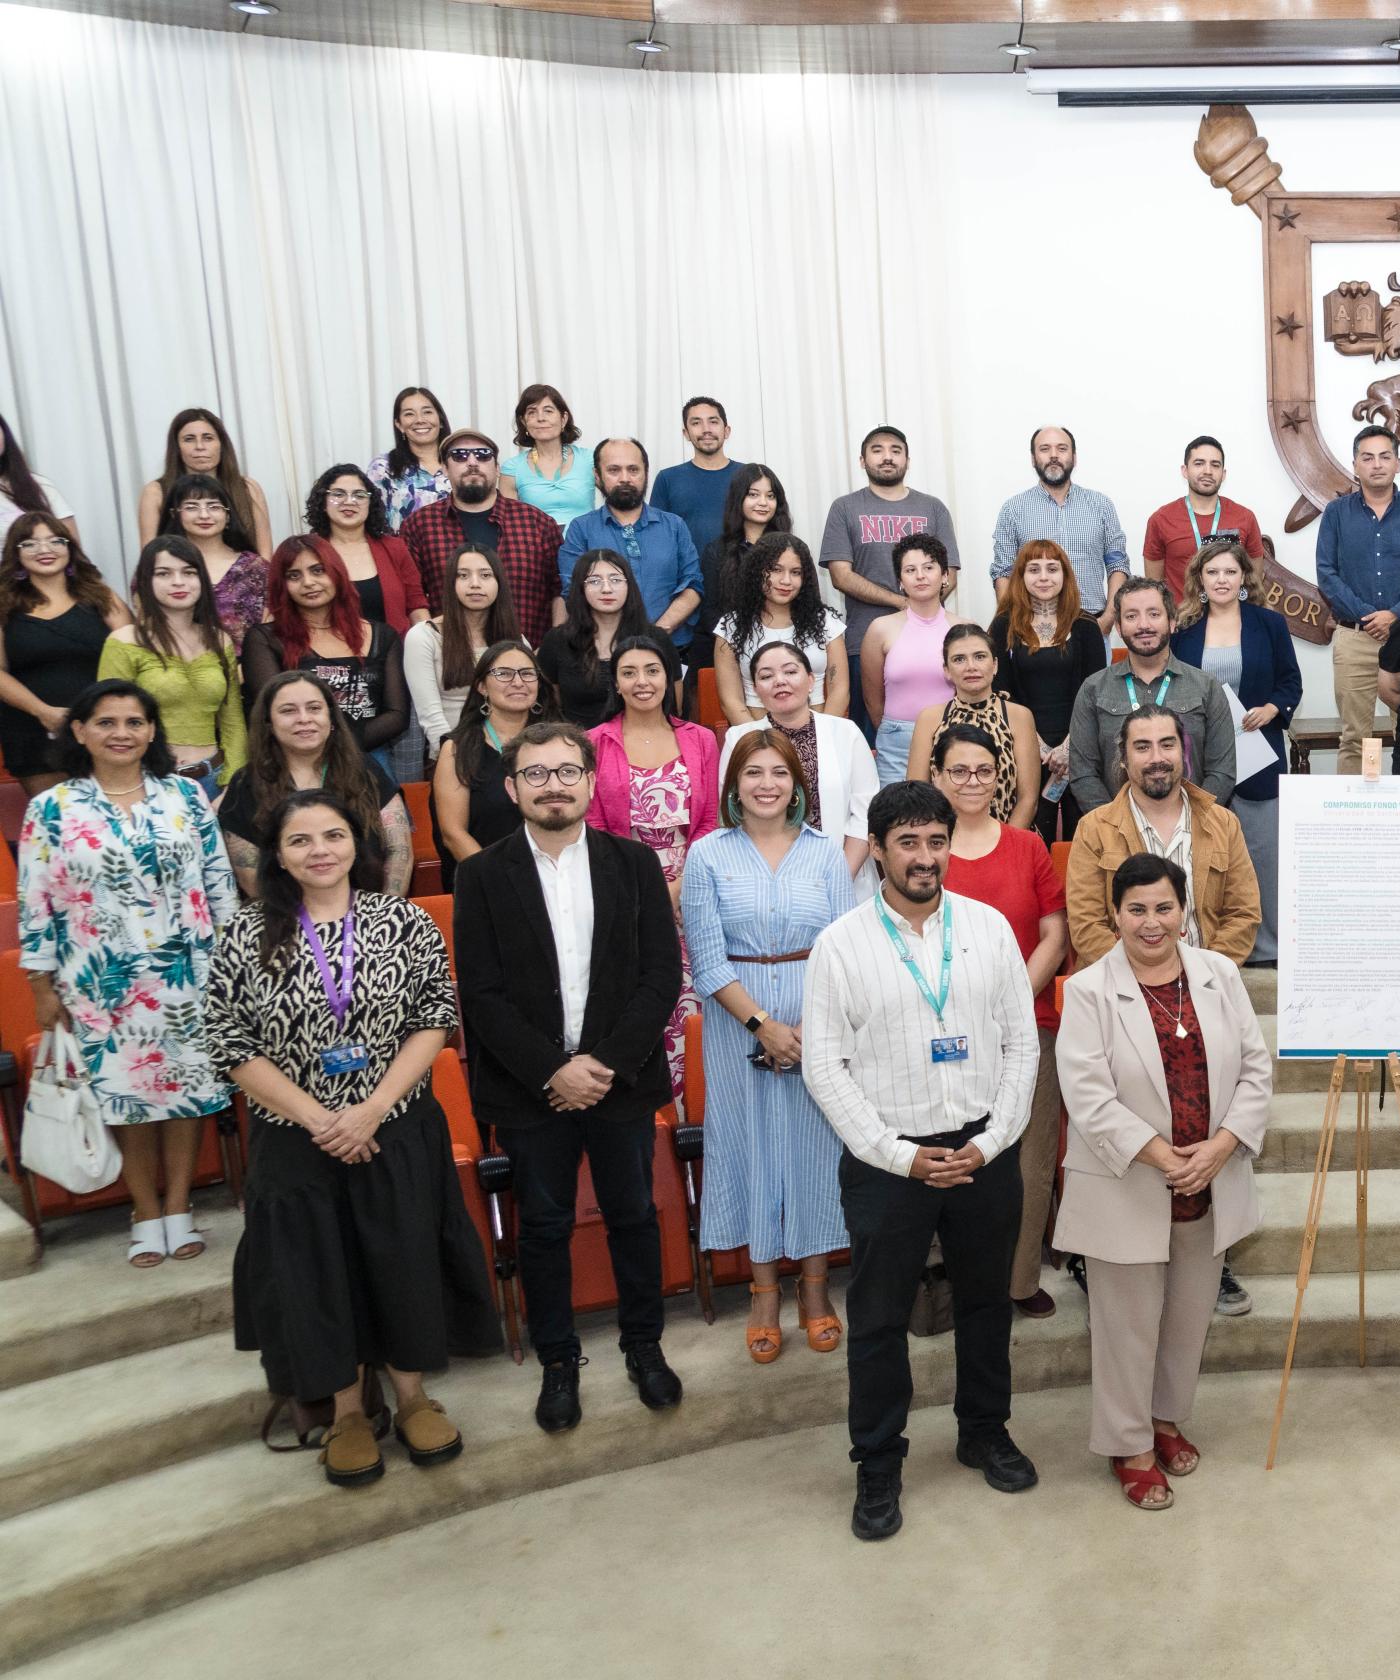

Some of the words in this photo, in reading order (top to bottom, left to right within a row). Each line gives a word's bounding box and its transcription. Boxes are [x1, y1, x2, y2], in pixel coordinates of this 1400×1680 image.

[859, 515, 928, 543] NIKE
[1266, 582, 1321, 626] BOR
[1323, 801, 1372, 809] COMPROMISO
[1373, 801, 1398, 809] FONDO
